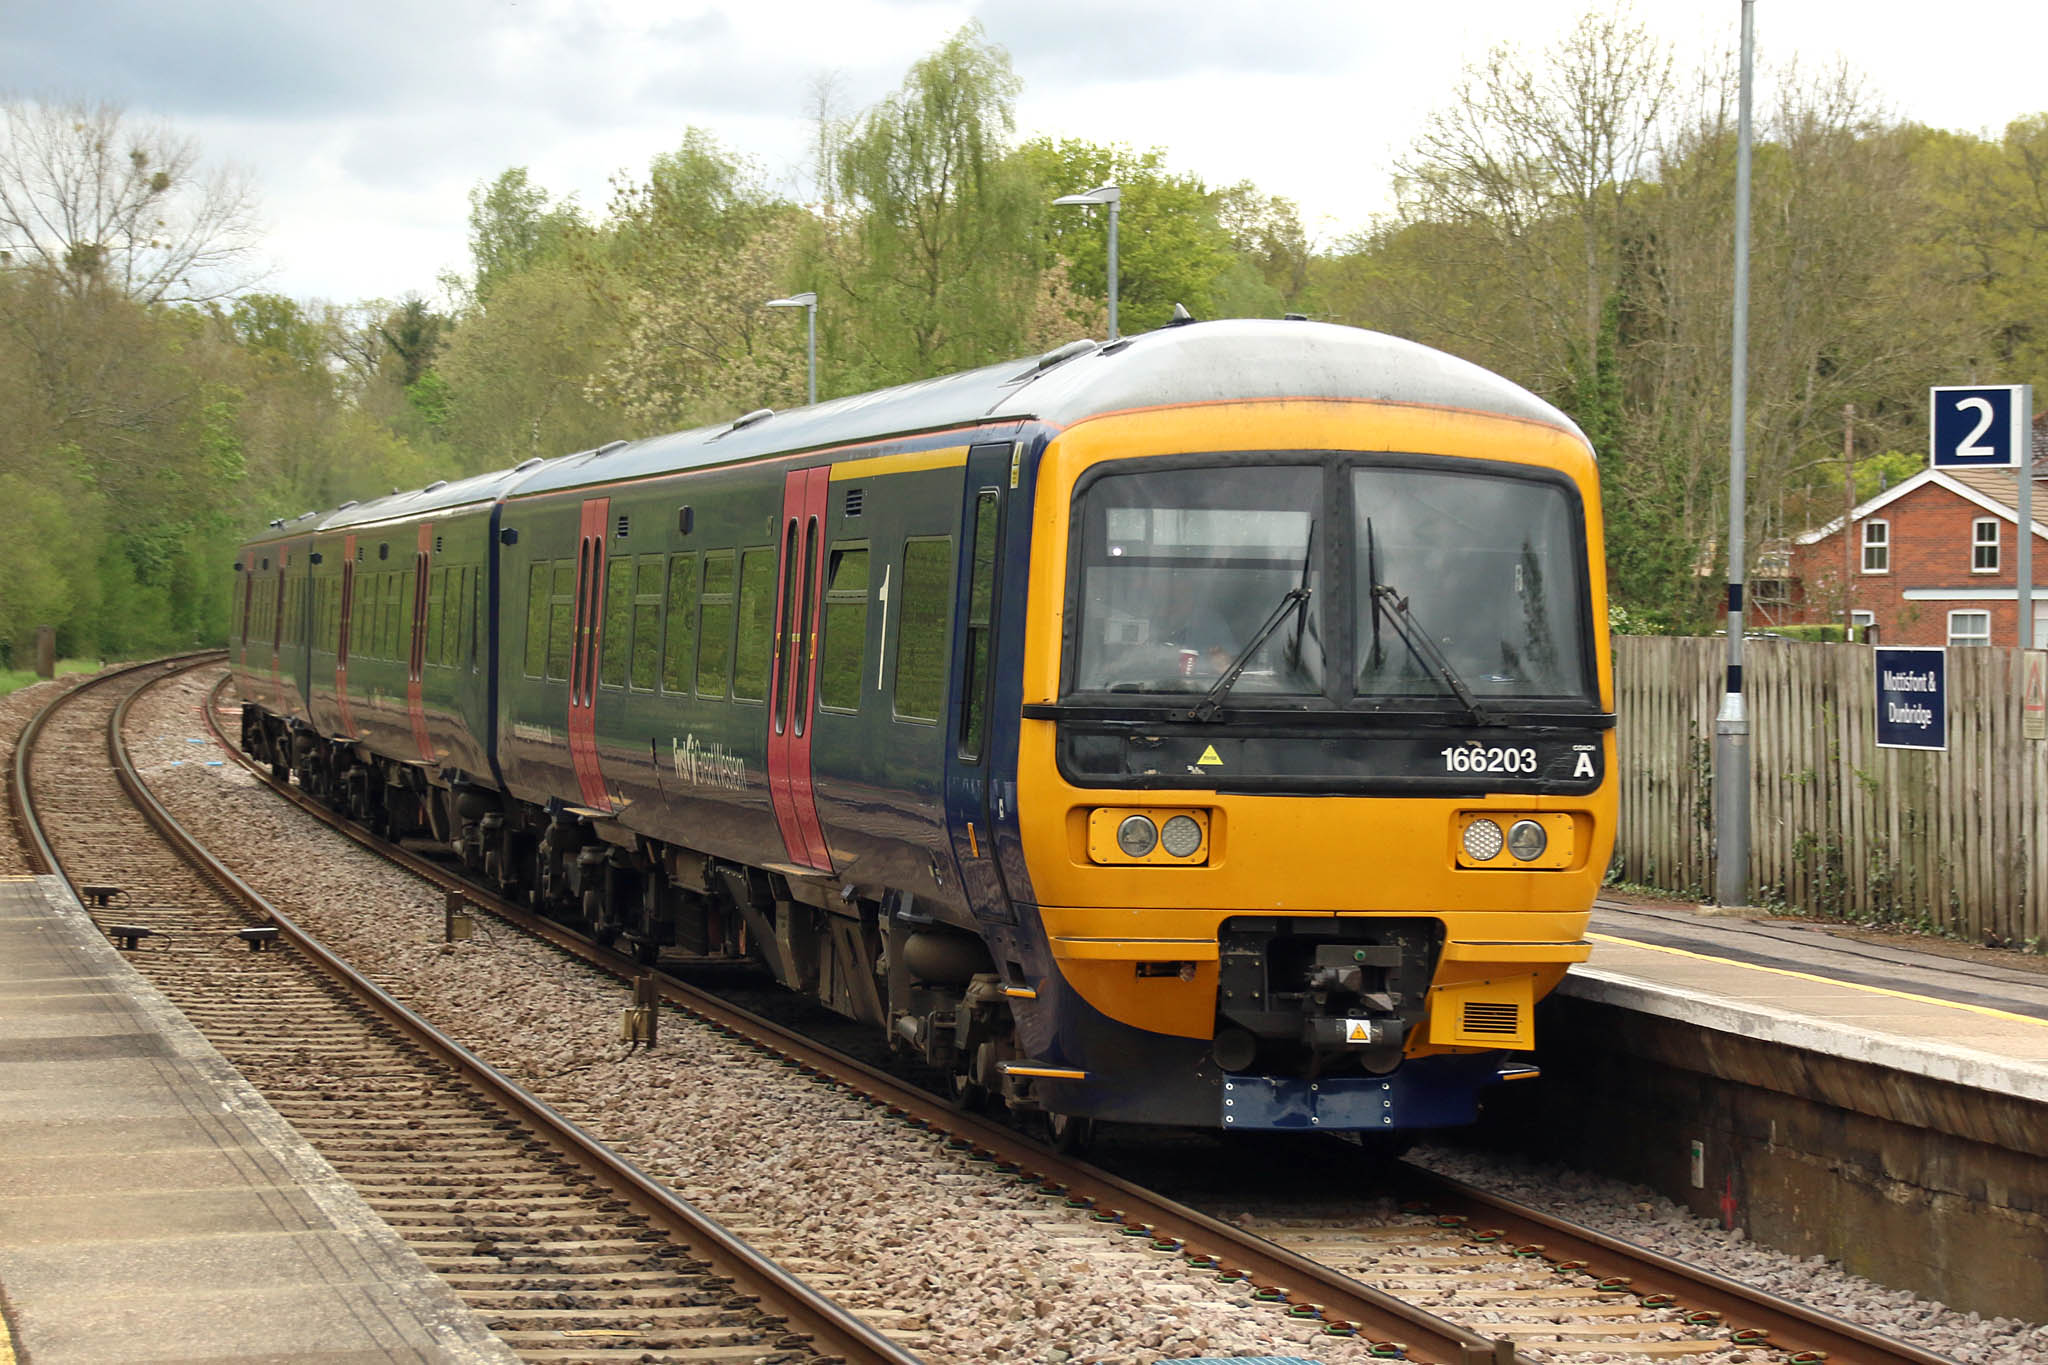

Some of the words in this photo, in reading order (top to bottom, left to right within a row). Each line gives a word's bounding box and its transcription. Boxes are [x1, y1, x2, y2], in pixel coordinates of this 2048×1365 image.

[1955, 397, 1994, 456] 2
[878, 563, 890, 690] 1
[1883, 670, 1927, 692] Mottisfont
[1928, 671, 1937, 692] &
[1888, 702, 1932, 729] Dunbridge
[1441, 747, 1537, 773] 166203
[1573, 752, 1595, 777] A
